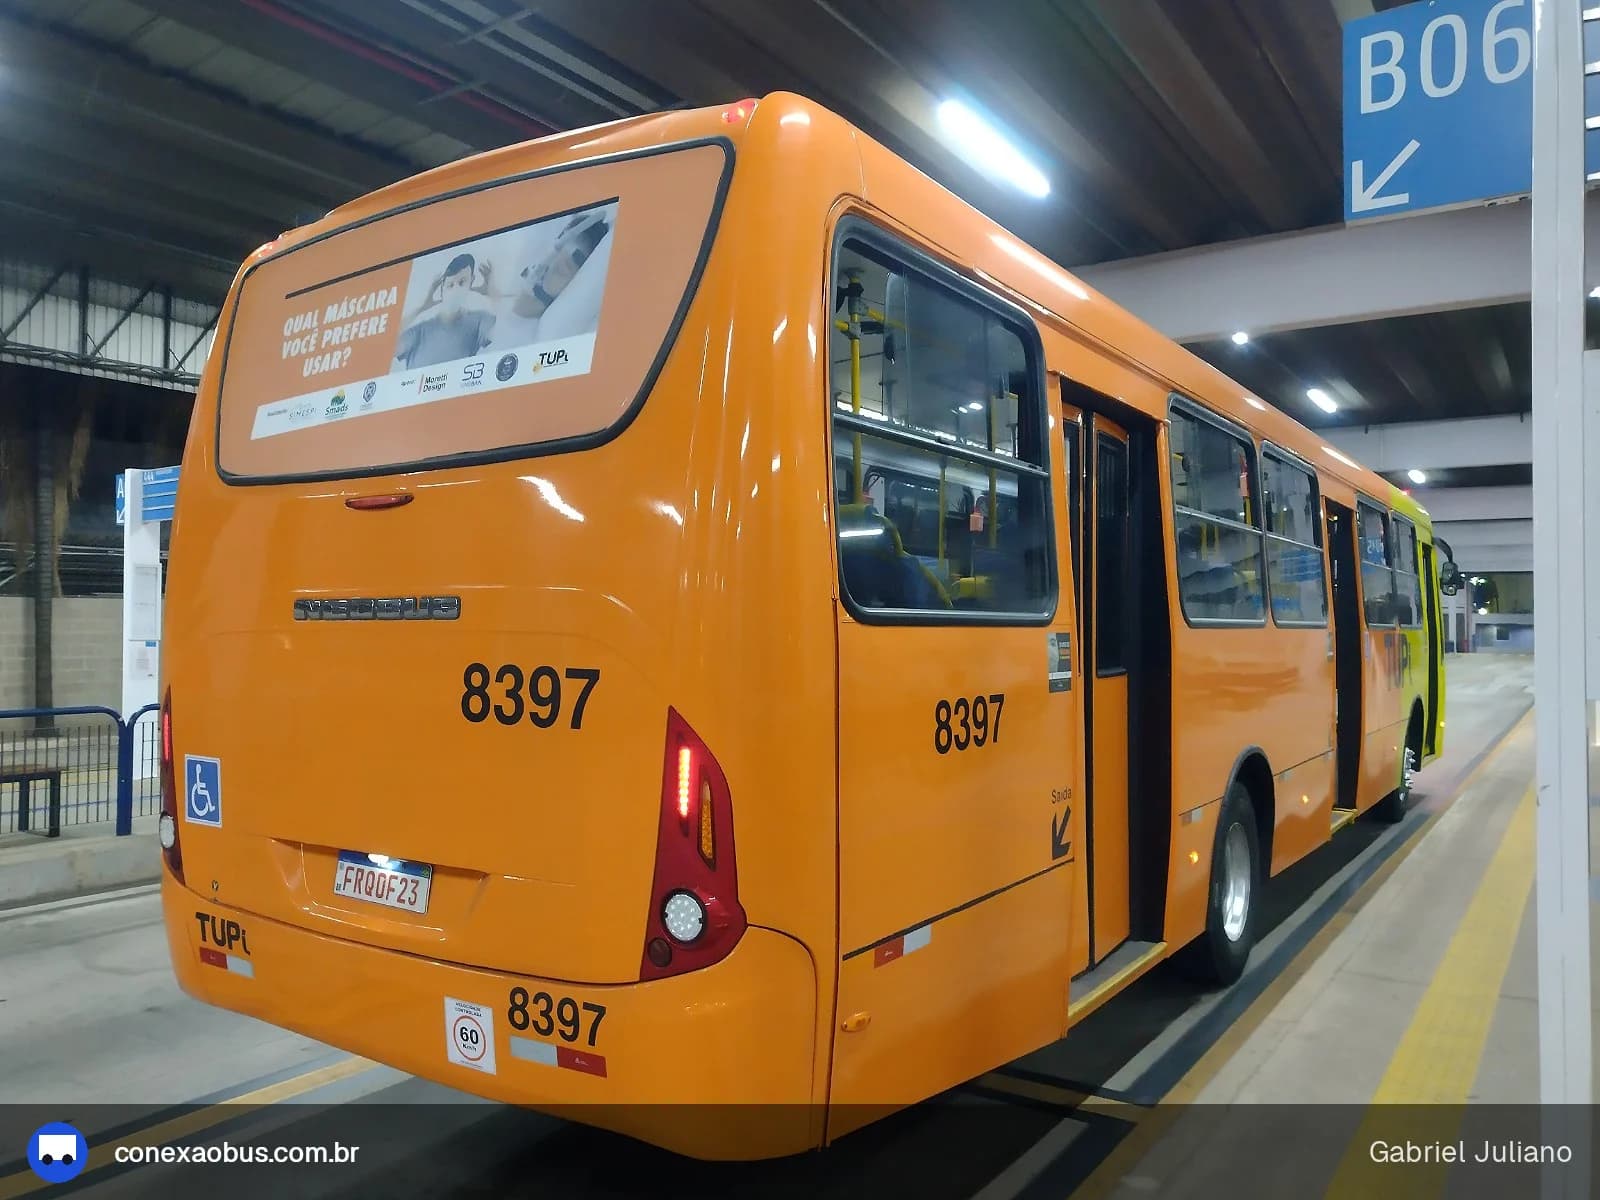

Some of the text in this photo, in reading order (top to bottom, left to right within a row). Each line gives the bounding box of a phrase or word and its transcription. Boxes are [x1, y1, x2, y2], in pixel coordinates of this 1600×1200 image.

[1360, 0, 1531, 114] B06
[283, 286, 398, 337] QUAL MÁSCARA
[282, 313, 389, 359] VOCÊ PREFERE
[303, 345, 352, 377] USAR?
[424, 373, 448, 385] Moretti
[324, 404, 349, 416] Smads
[423, 382, 446, 392] Design
[461, 662, 600, 730] 8397
[934, 693, 1005, 755] 8397
[460, 1026, 479, 1045] 60
[508, 986, 606, 1047] 8397
